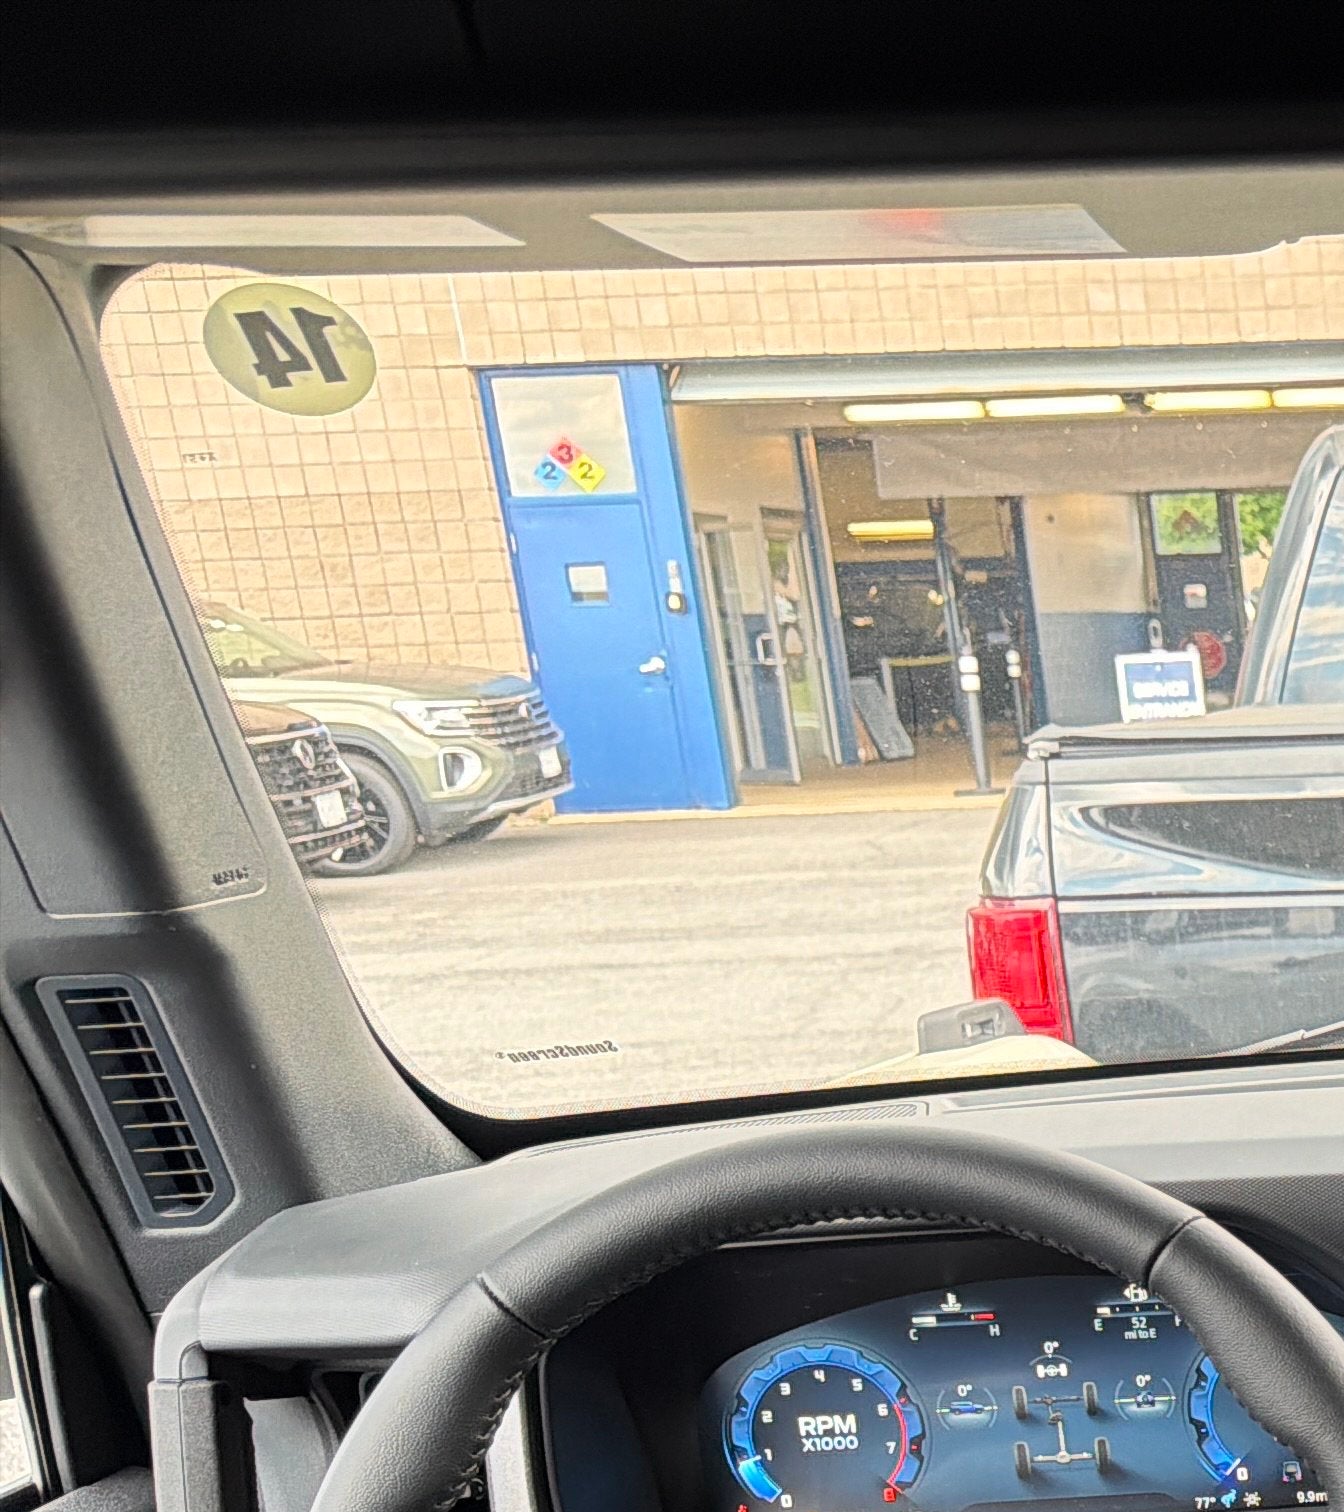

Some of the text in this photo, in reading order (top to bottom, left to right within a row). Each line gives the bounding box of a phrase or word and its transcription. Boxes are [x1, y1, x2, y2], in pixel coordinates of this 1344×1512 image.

[557, 443, 574, 465] 3
[541, 461, 558, 480] 2
[578, 461, 595, 480] 2
[1094, 1319, 1104, 1331] E
[1131, 1317, 1147, 1329] 52
[989, 1325, 1000, 1337] H
[812, 1370, 825, 1382] 4
[779, 1383, 791, 1395] 3
[851, 1379, 863, 1391] 5
[877, 1404, 888, 1416] 6
[761, 1411, 773, 1423] 2
[798, 1414, 857, 1436] RPM
[802, 1436, 859, 1453] X1000
[886, 1441, 896, 1454] 7
[764, 1449, 773, 1461] 1
[780, 1495, 793, 1508] 0
